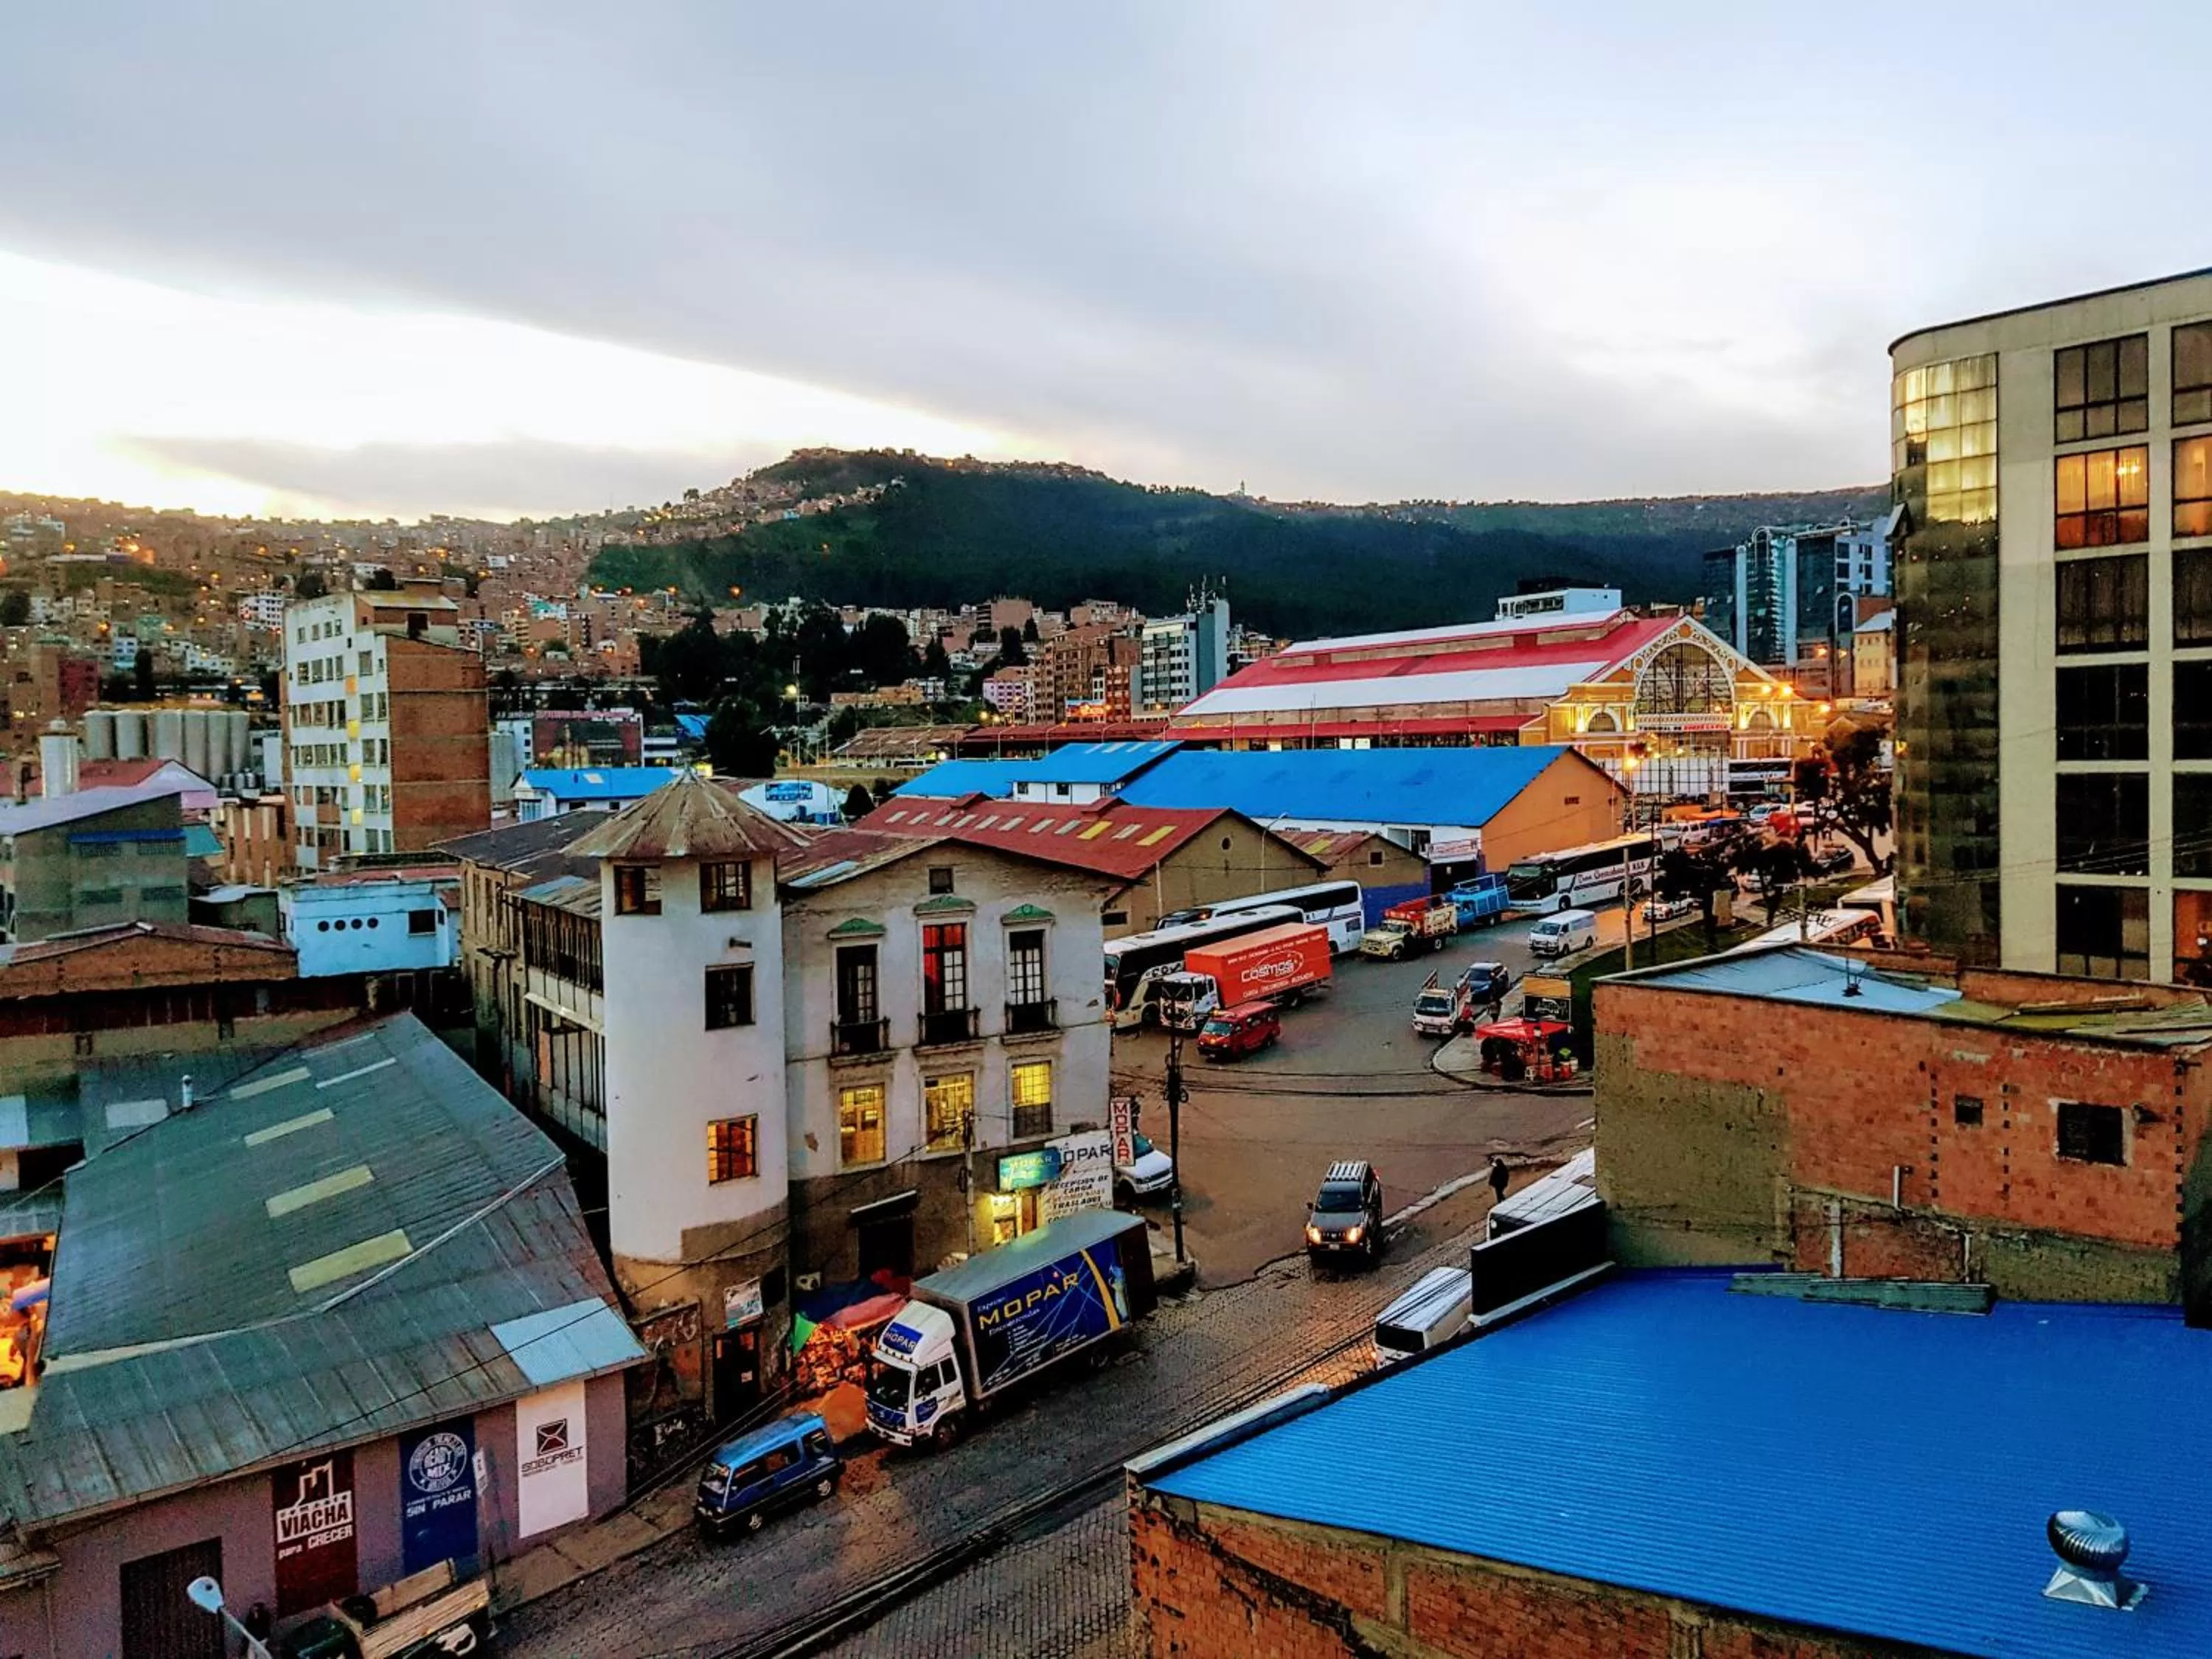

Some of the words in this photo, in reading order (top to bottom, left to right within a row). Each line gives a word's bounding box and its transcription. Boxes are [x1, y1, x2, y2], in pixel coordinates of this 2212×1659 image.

[1113, 1102, 1131, 1162] MOPAR
[978, 1273, 1079, 1331] MOPAR
[886, 1331, 917, 1352] MOPAR
[423, 1447, 453, 1469] READY
[426, 1462, 451, 1478] MIX
[406, 1501, 425, 1517] SIN
[432, 1489, 472, 1510] PARAR
[280, 1502, 349, 1538] VIACHA
[307, 1524, 354, 1550] CRECER
